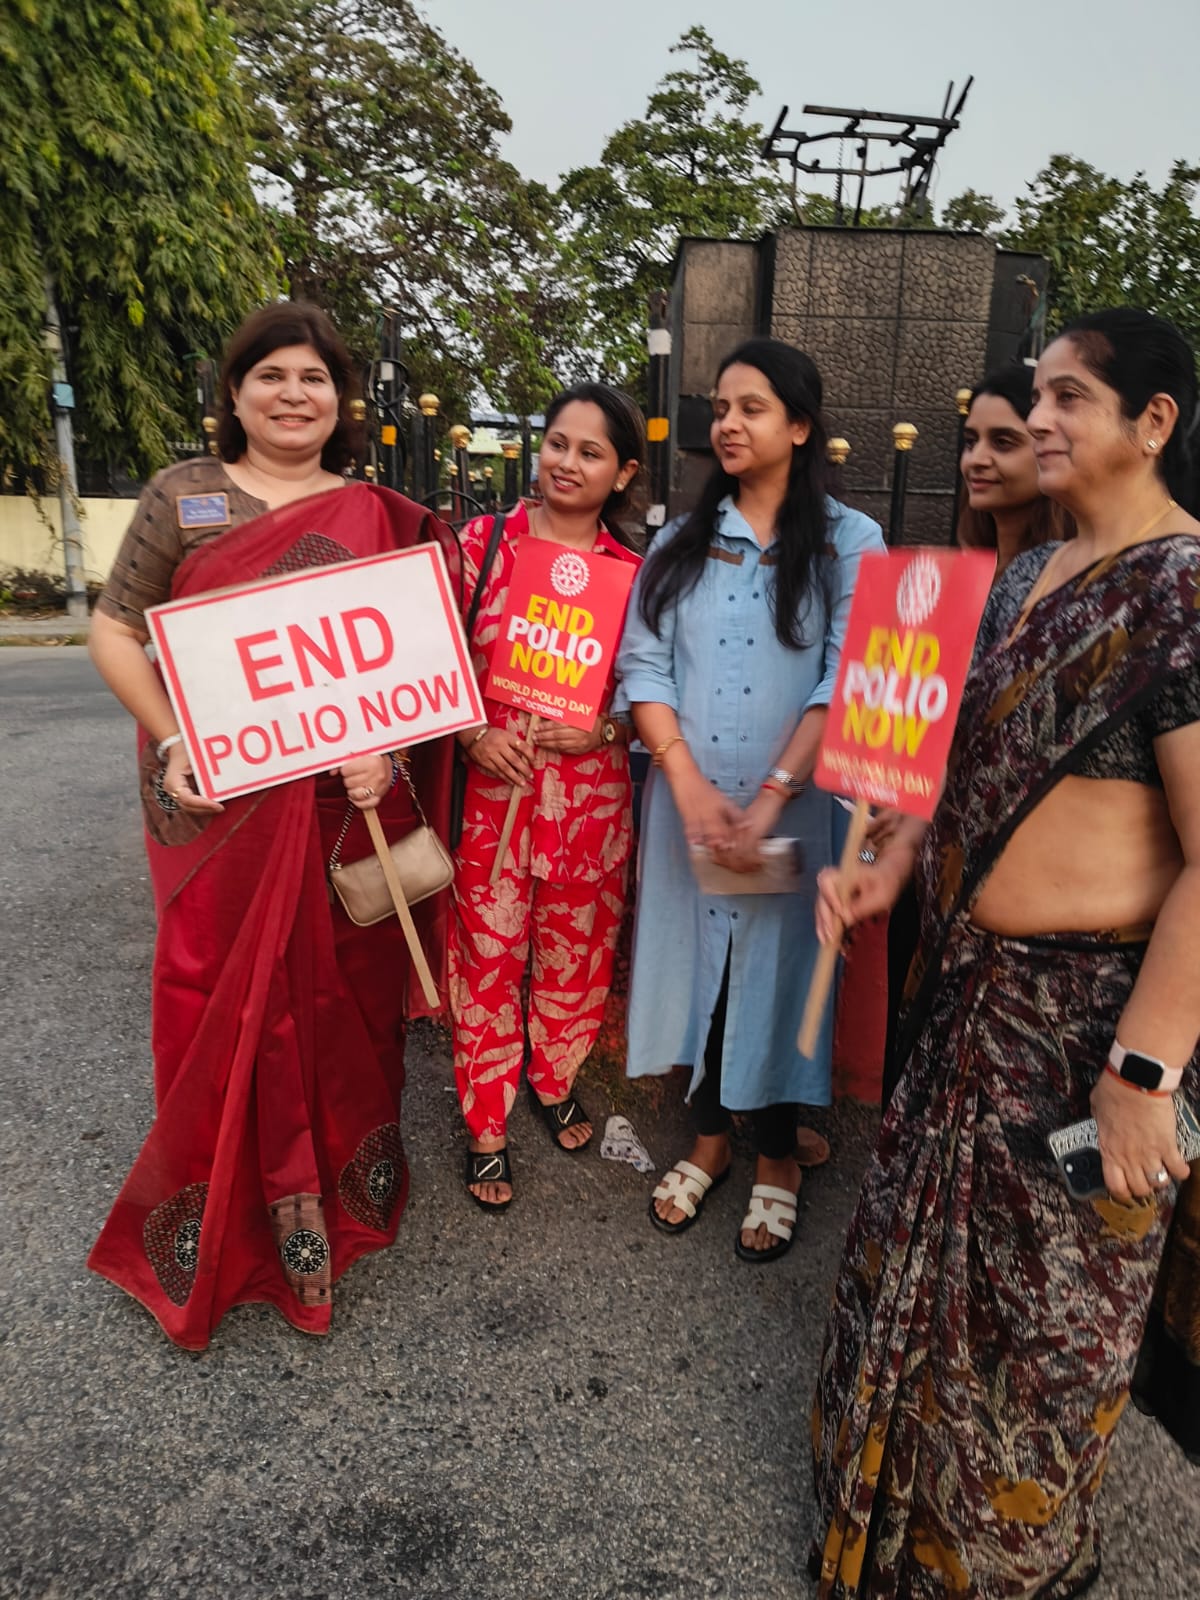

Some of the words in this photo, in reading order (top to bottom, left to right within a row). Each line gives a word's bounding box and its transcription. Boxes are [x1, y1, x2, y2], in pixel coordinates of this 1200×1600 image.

[507, 615, 603, 666] POLIO
[526, 594, 594, 637] END
[234, 606, 394, 701] END
[510, 641, 588, 688] NOW
[865, 626, 940, 680] END
[492, 675, 531, 696] WORLD
[531, 689, 567, 709] POLIO
[568, 701, 594, 716] DAY
[525, 700, 564, 719] OCTOBER
[843, 660, 948, 722] POLIO
[203, 704, 347, 776] POLIO
[358, 671, 460, 732] NOW
[842, 700, 930, 758] NOW
